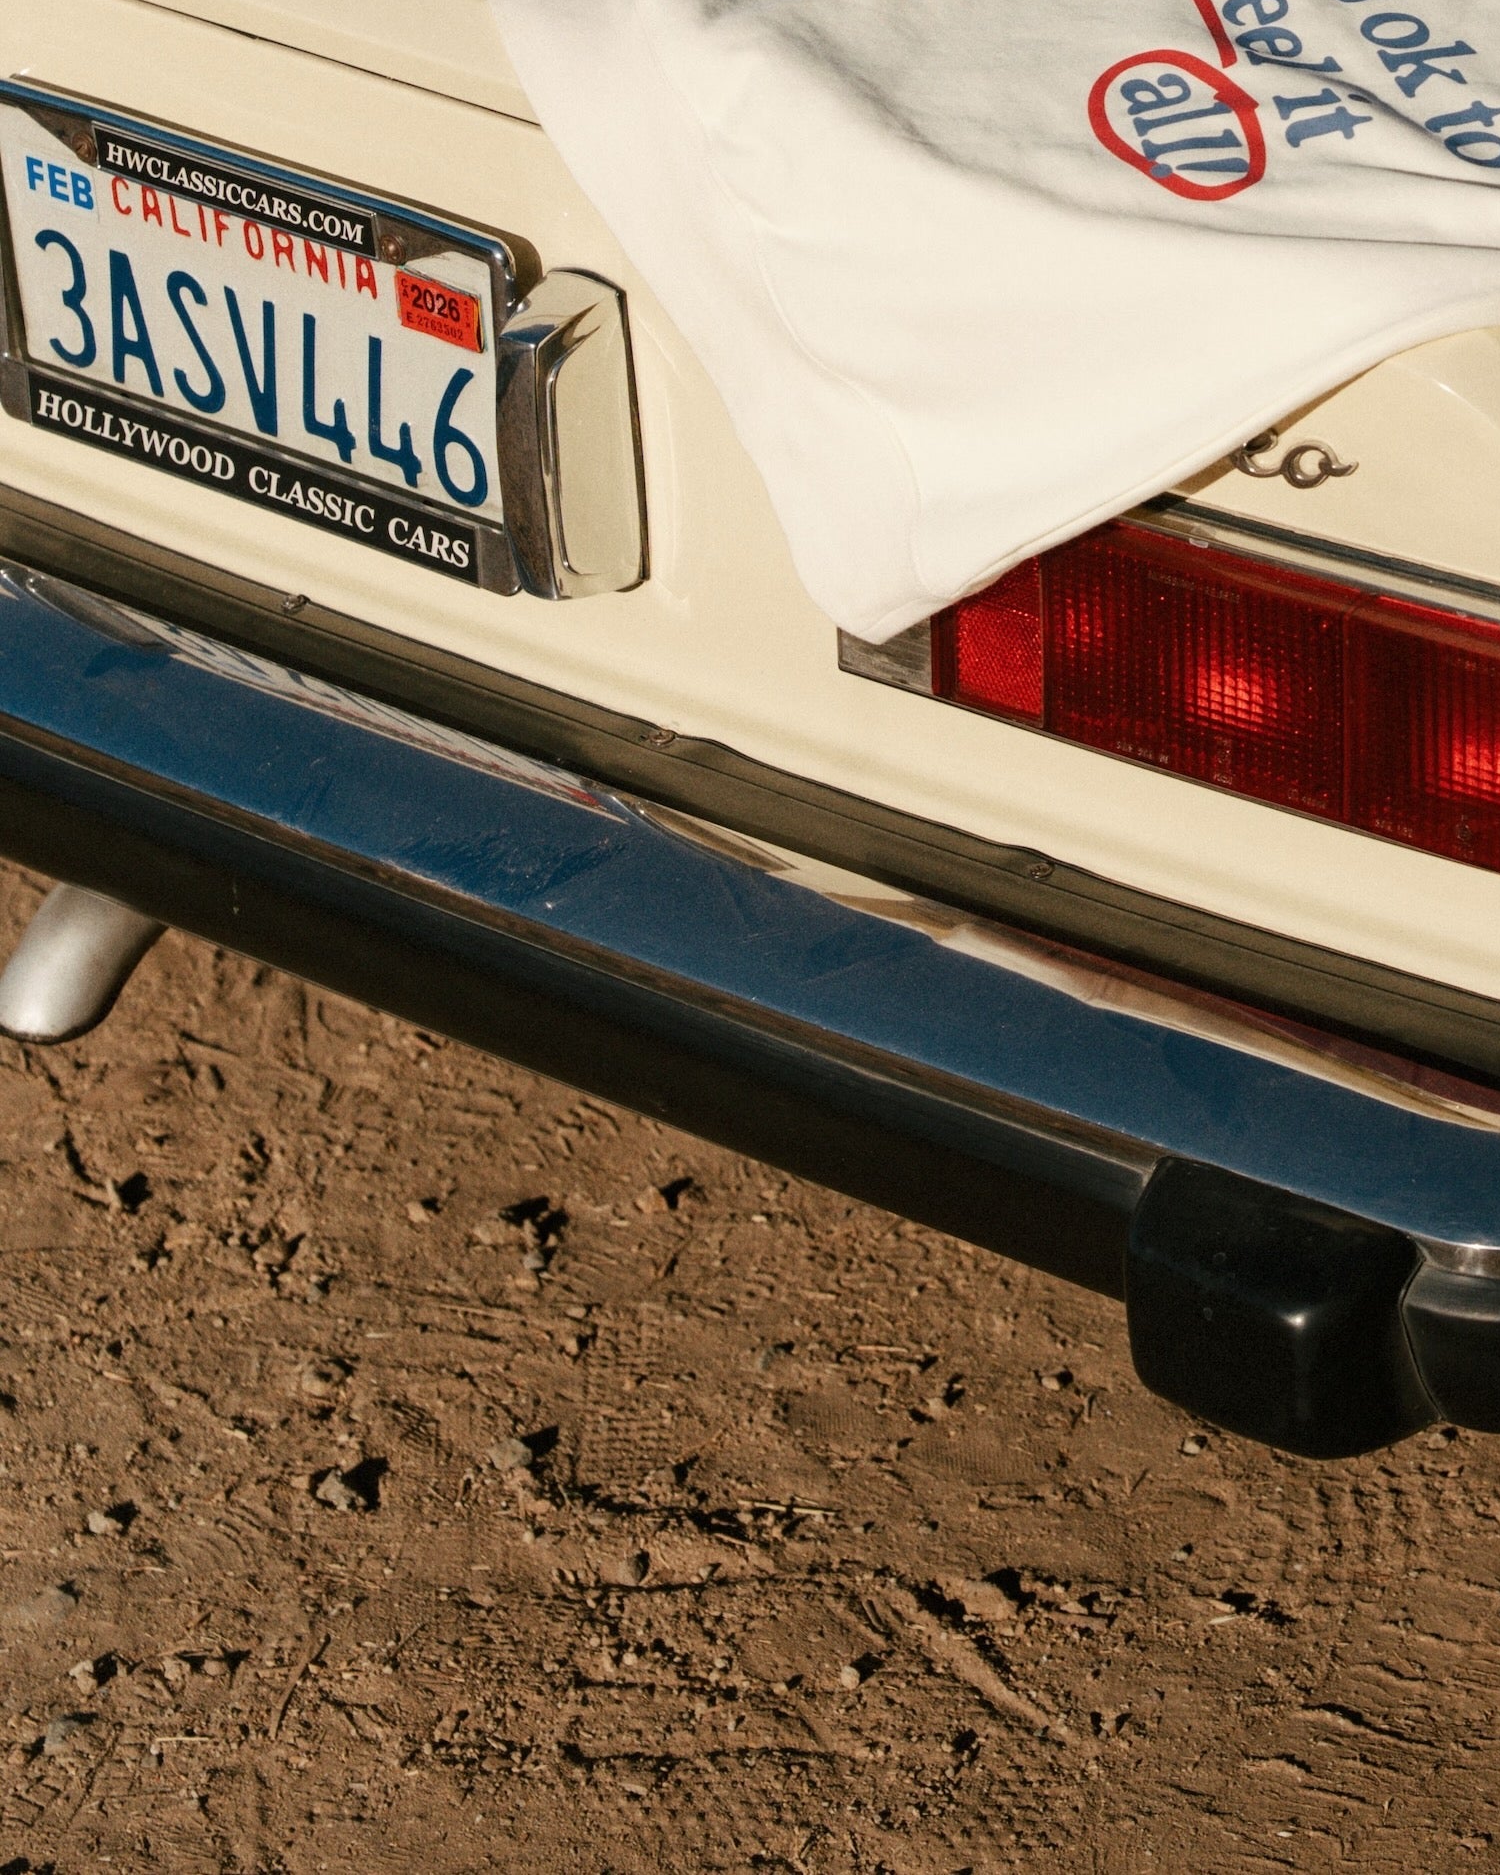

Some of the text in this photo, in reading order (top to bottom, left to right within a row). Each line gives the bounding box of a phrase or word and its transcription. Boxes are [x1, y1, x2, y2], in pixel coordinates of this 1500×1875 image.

[1360, 12, 1477, 98] ok
[1119, 72, 1250, 179] all!
[1272, 86, 1377, 148] it
[26, 155, 94, 211] FEB
[106, 142, 364, 245] HWCLASSICCARS.COM
[111, 175, 378, 300] CALIFORNIA
[411, 283, 461, 323] 2026
[35, 229, 488, 508] 3ASV446
[36, 389, 470, 569] HOLLYWOOD CLASSIC CARS
